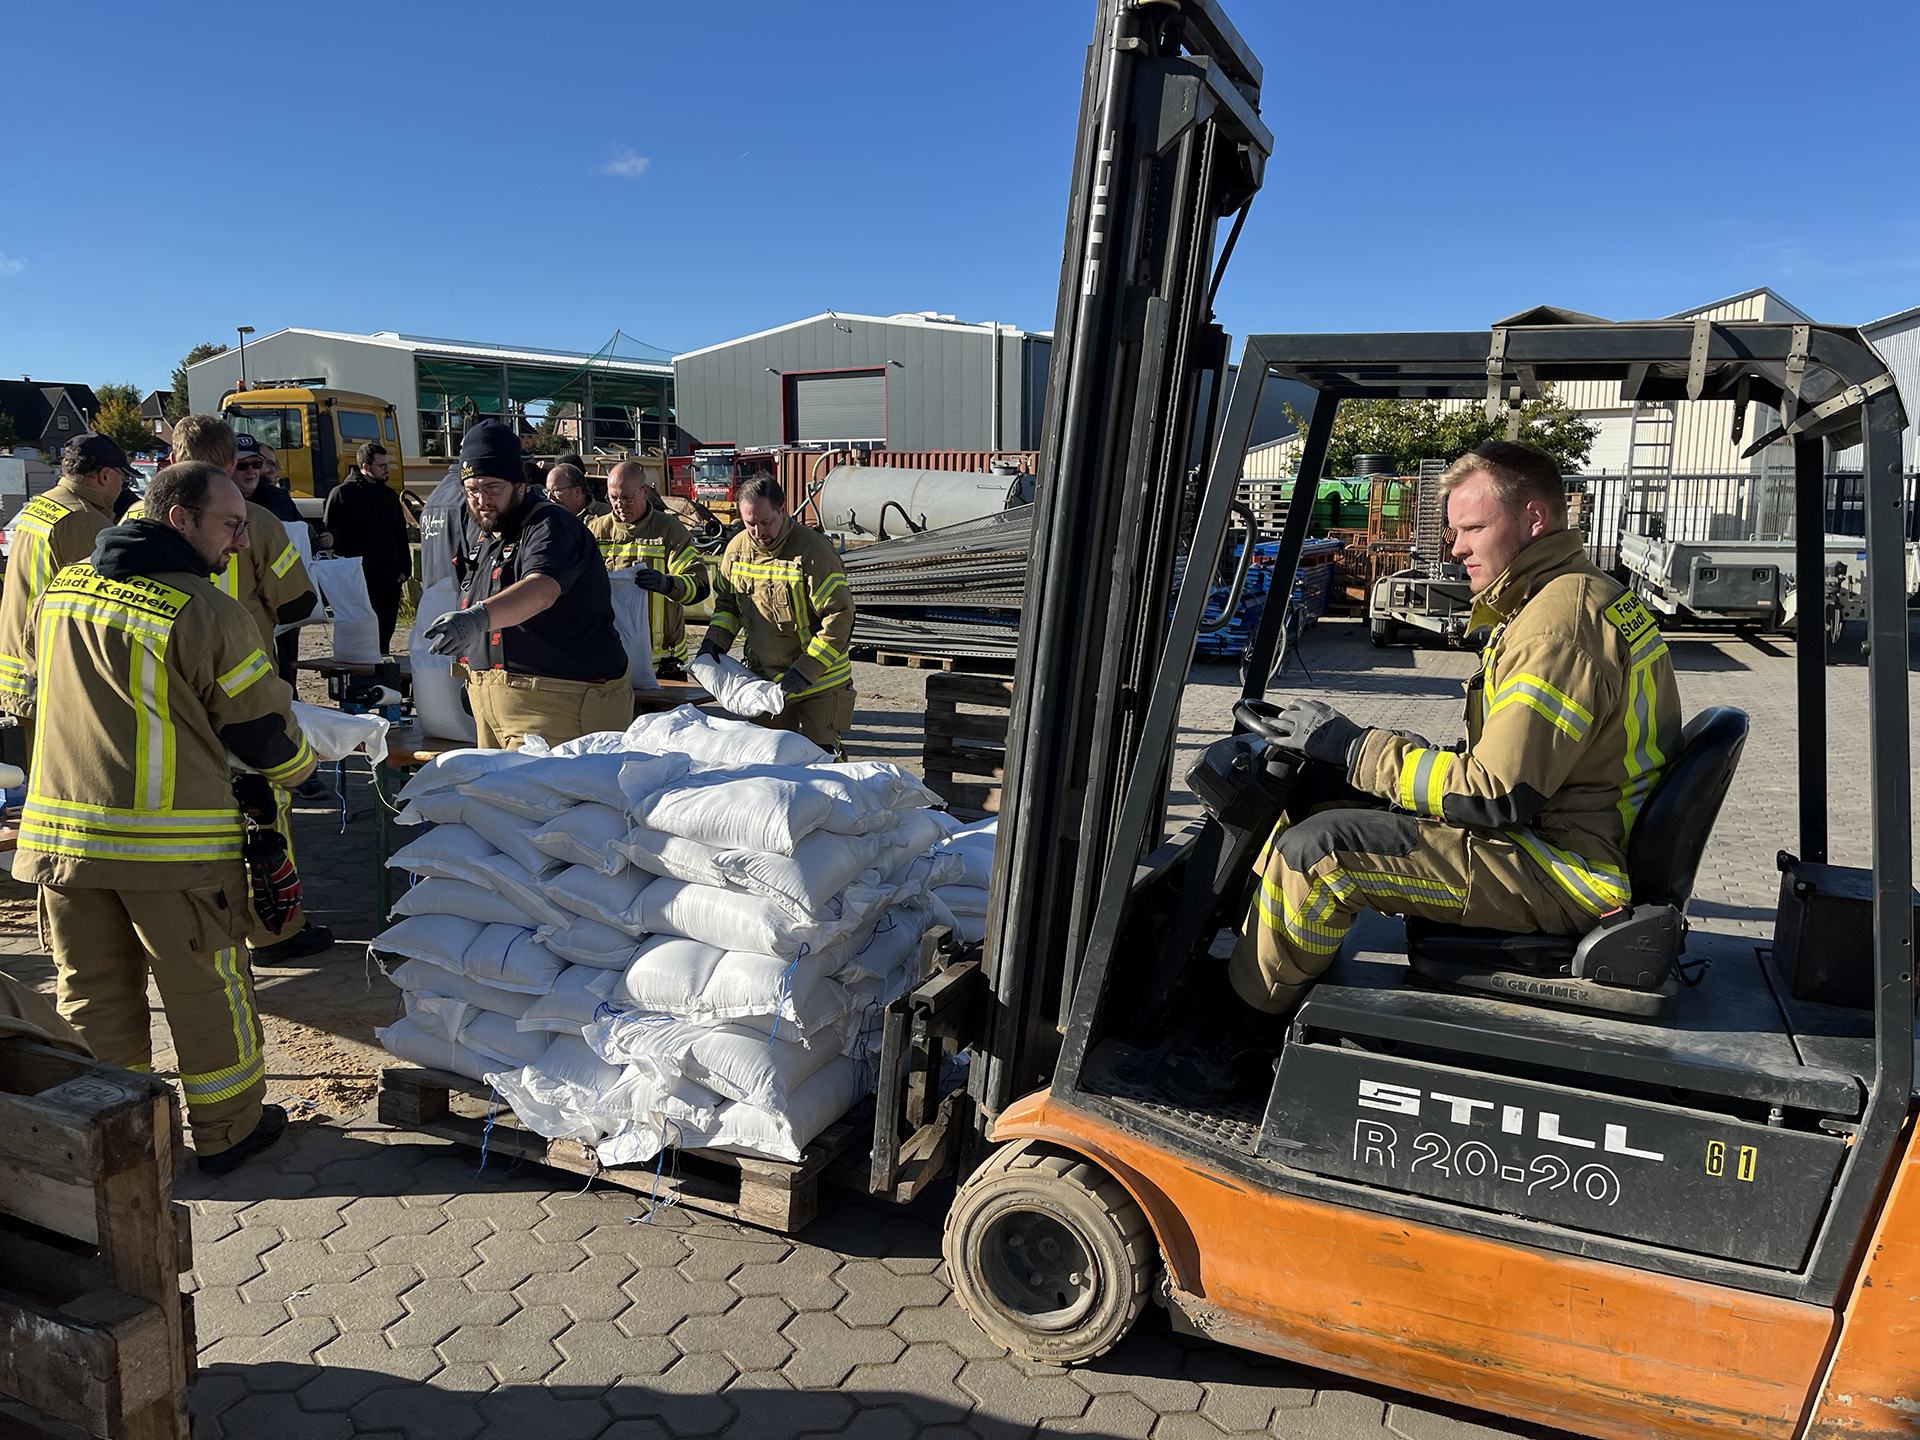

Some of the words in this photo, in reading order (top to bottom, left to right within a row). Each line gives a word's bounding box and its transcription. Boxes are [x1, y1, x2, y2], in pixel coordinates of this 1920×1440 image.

[1083, 130, 1116, 295] STILL
[51, 577, 90, 588] Stadt
[94, 581, 178, 615] Kappeln
[1613, 596, 1640, 619] Feue
[1506, 979, 1589, 1001] GRAMMER
[1358, 1079, 1664, 1162] STILL
[1353, 1118, 1398, 1169] R
[1411, 1131, 1621, 1207] 20-20
